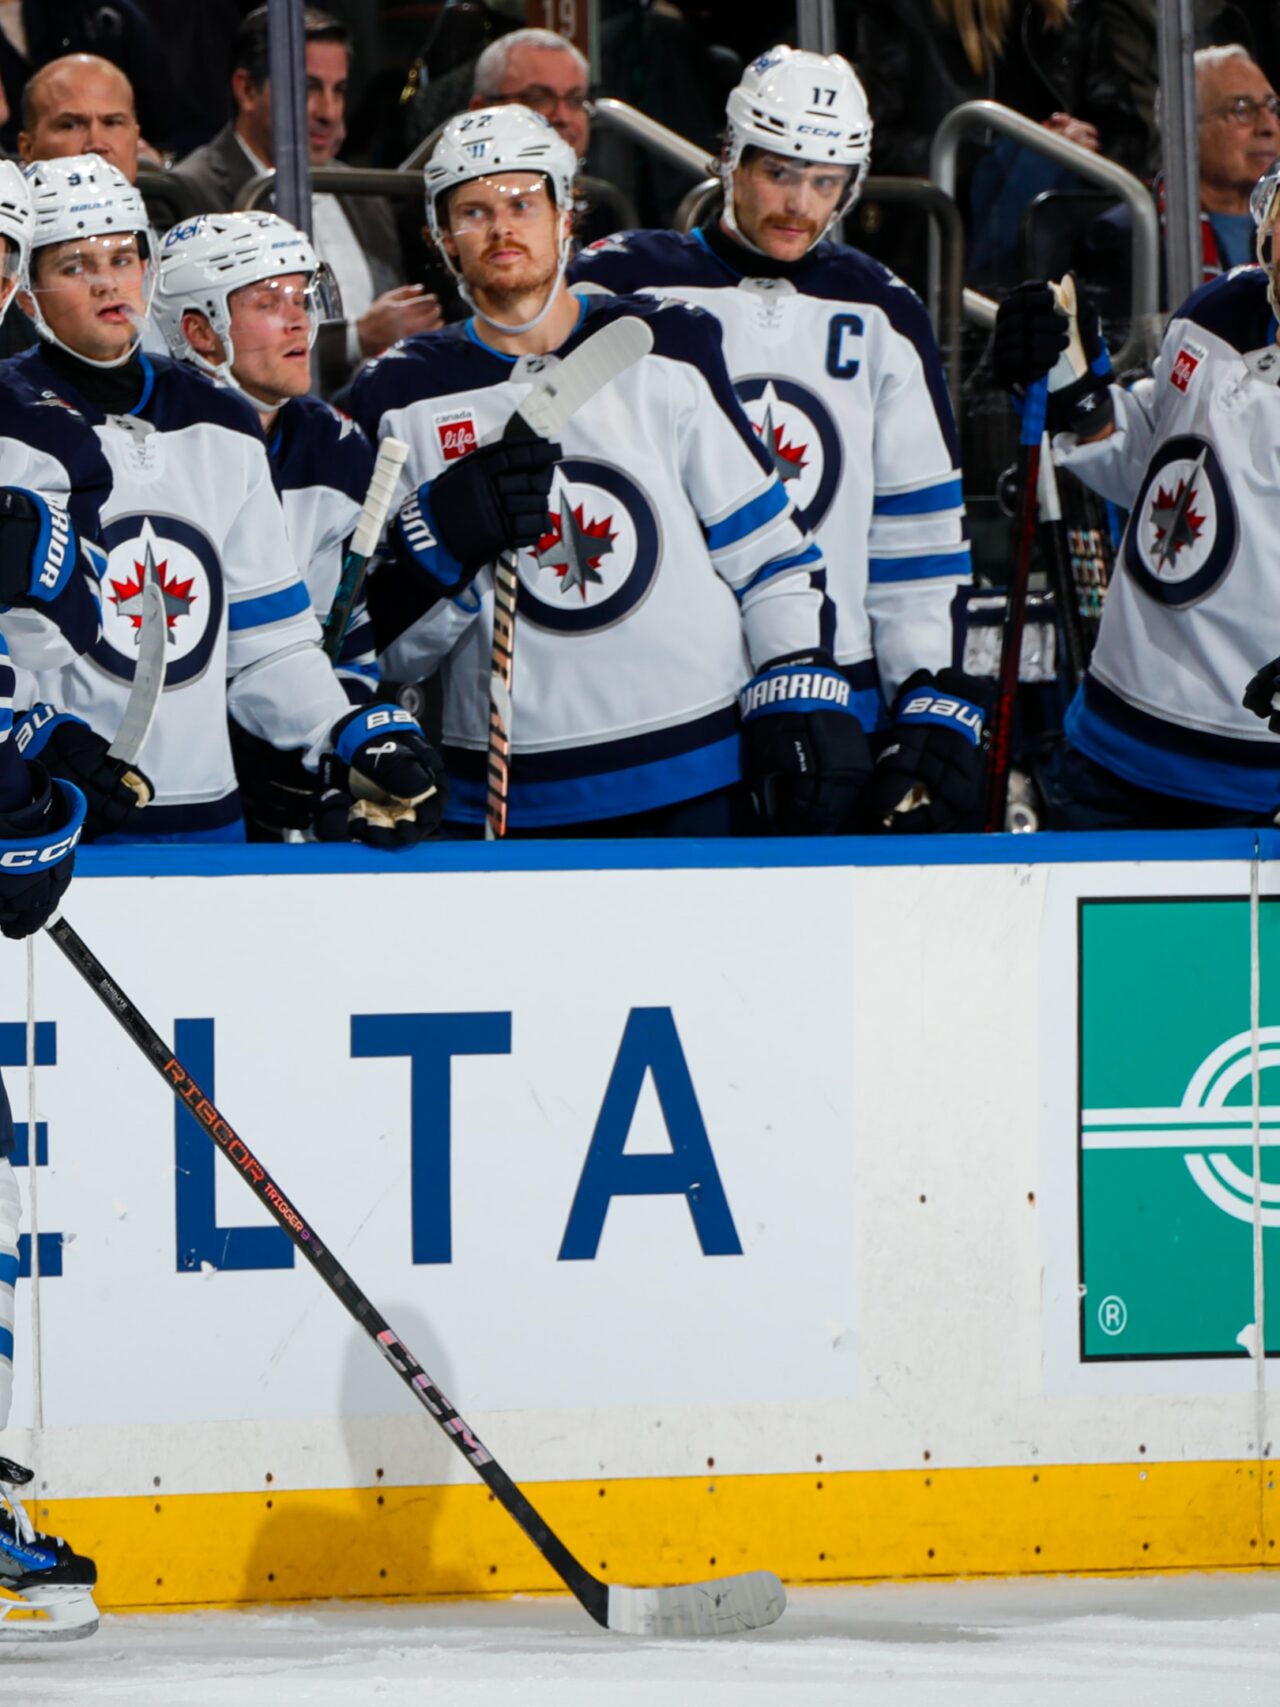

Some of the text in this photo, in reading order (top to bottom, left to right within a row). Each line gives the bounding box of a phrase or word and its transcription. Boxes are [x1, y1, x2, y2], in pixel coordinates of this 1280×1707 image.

[812, 86, 837, 107] 17
[797, 124, 842, 138] CCM
[824, 312, 865, 382] C
[442, 427, 476, 454] life
[163, 1058, 266, 1184] RIBCOR
[263, 1181, 304, 1234] TRIGGER
[376, 1328, 494, 1468] CCM
